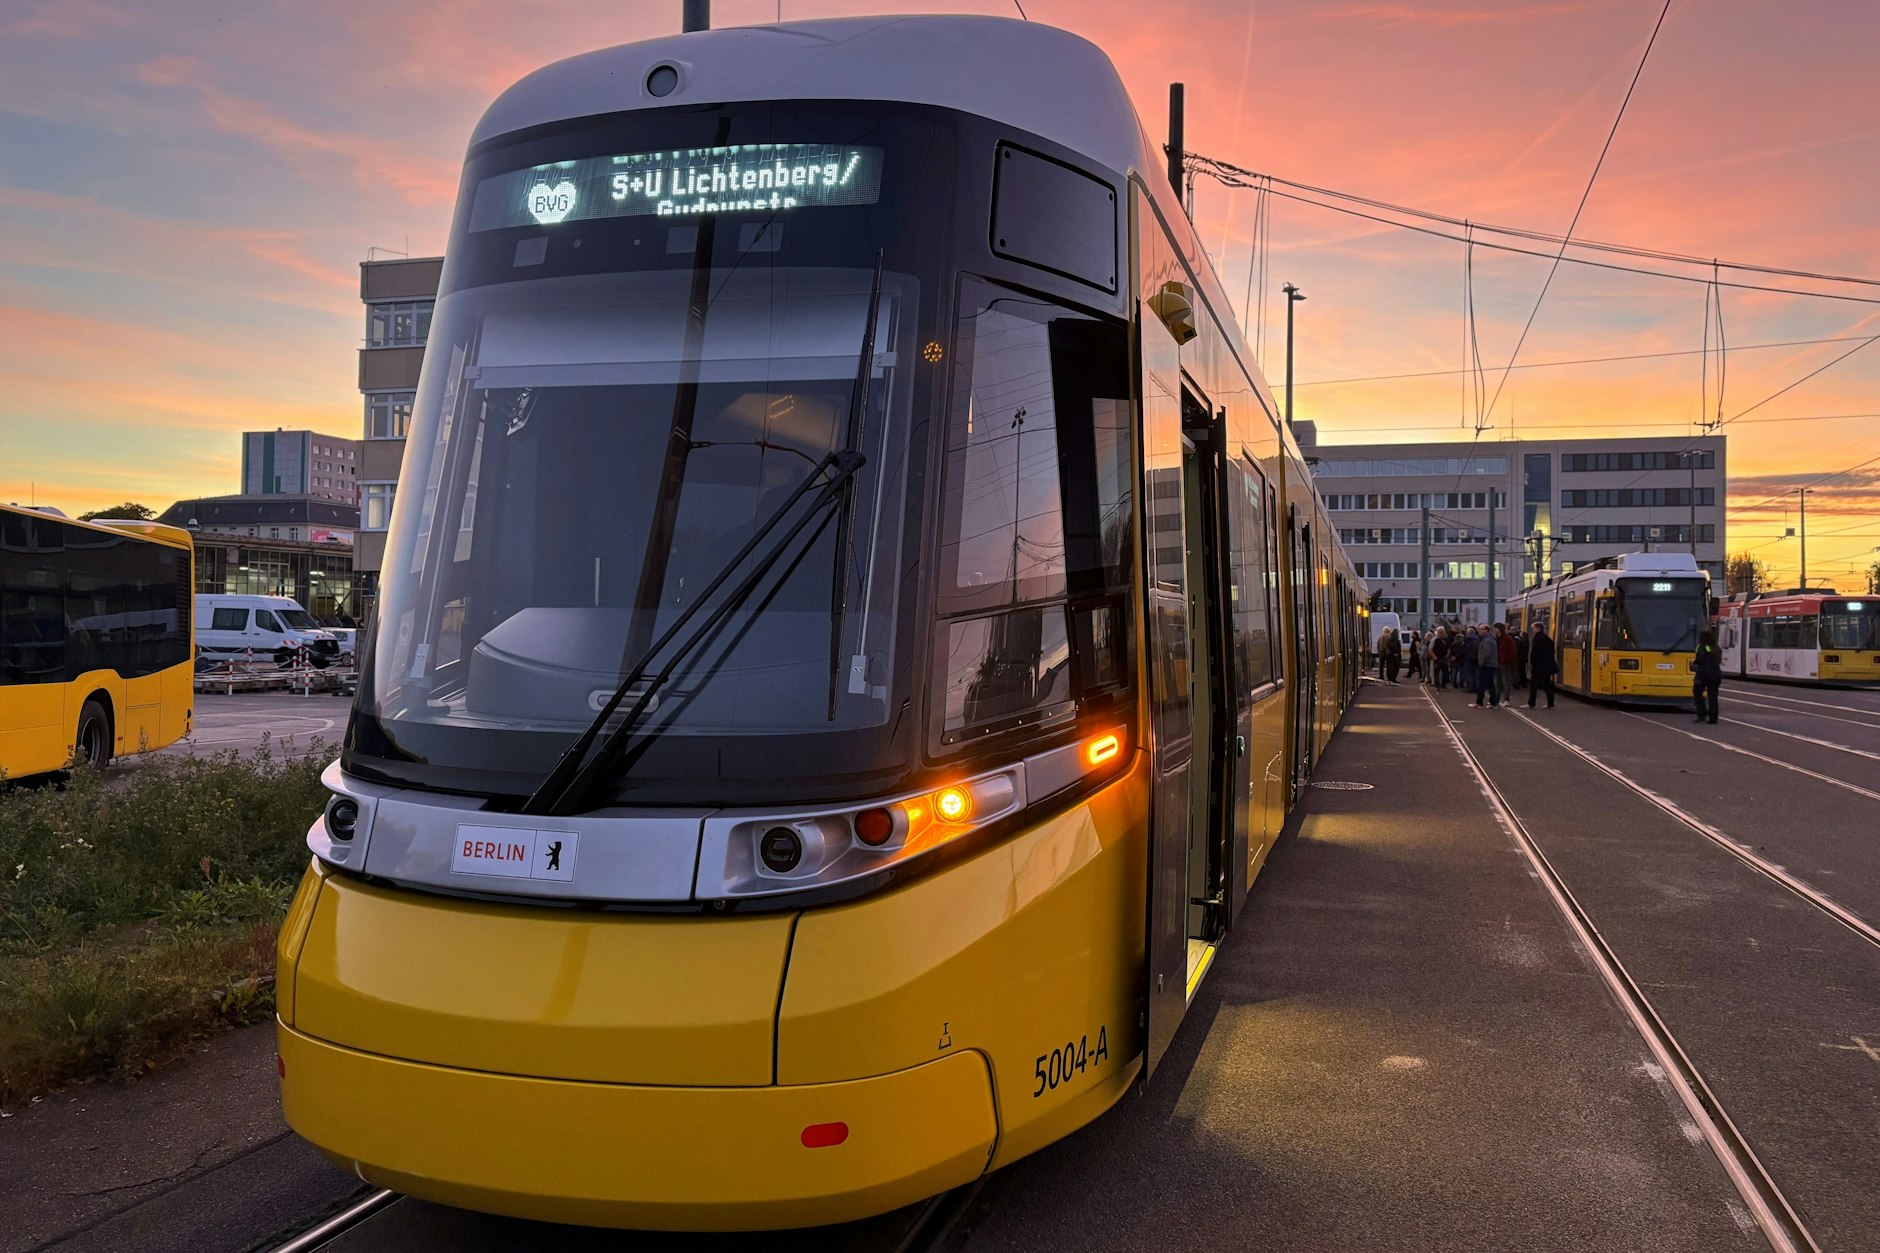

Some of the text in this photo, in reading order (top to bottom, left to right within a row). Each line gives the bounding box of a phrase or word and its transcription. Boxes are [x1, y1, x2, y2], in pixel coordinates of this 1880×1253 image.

[613, 151, 860, 199] S+U Lichtenberg/
[534, 194, 569, 213] BVG
[463, 840, 525, 862] BERLIN
[1033, 1024, 1109, 1098] 5004-A
